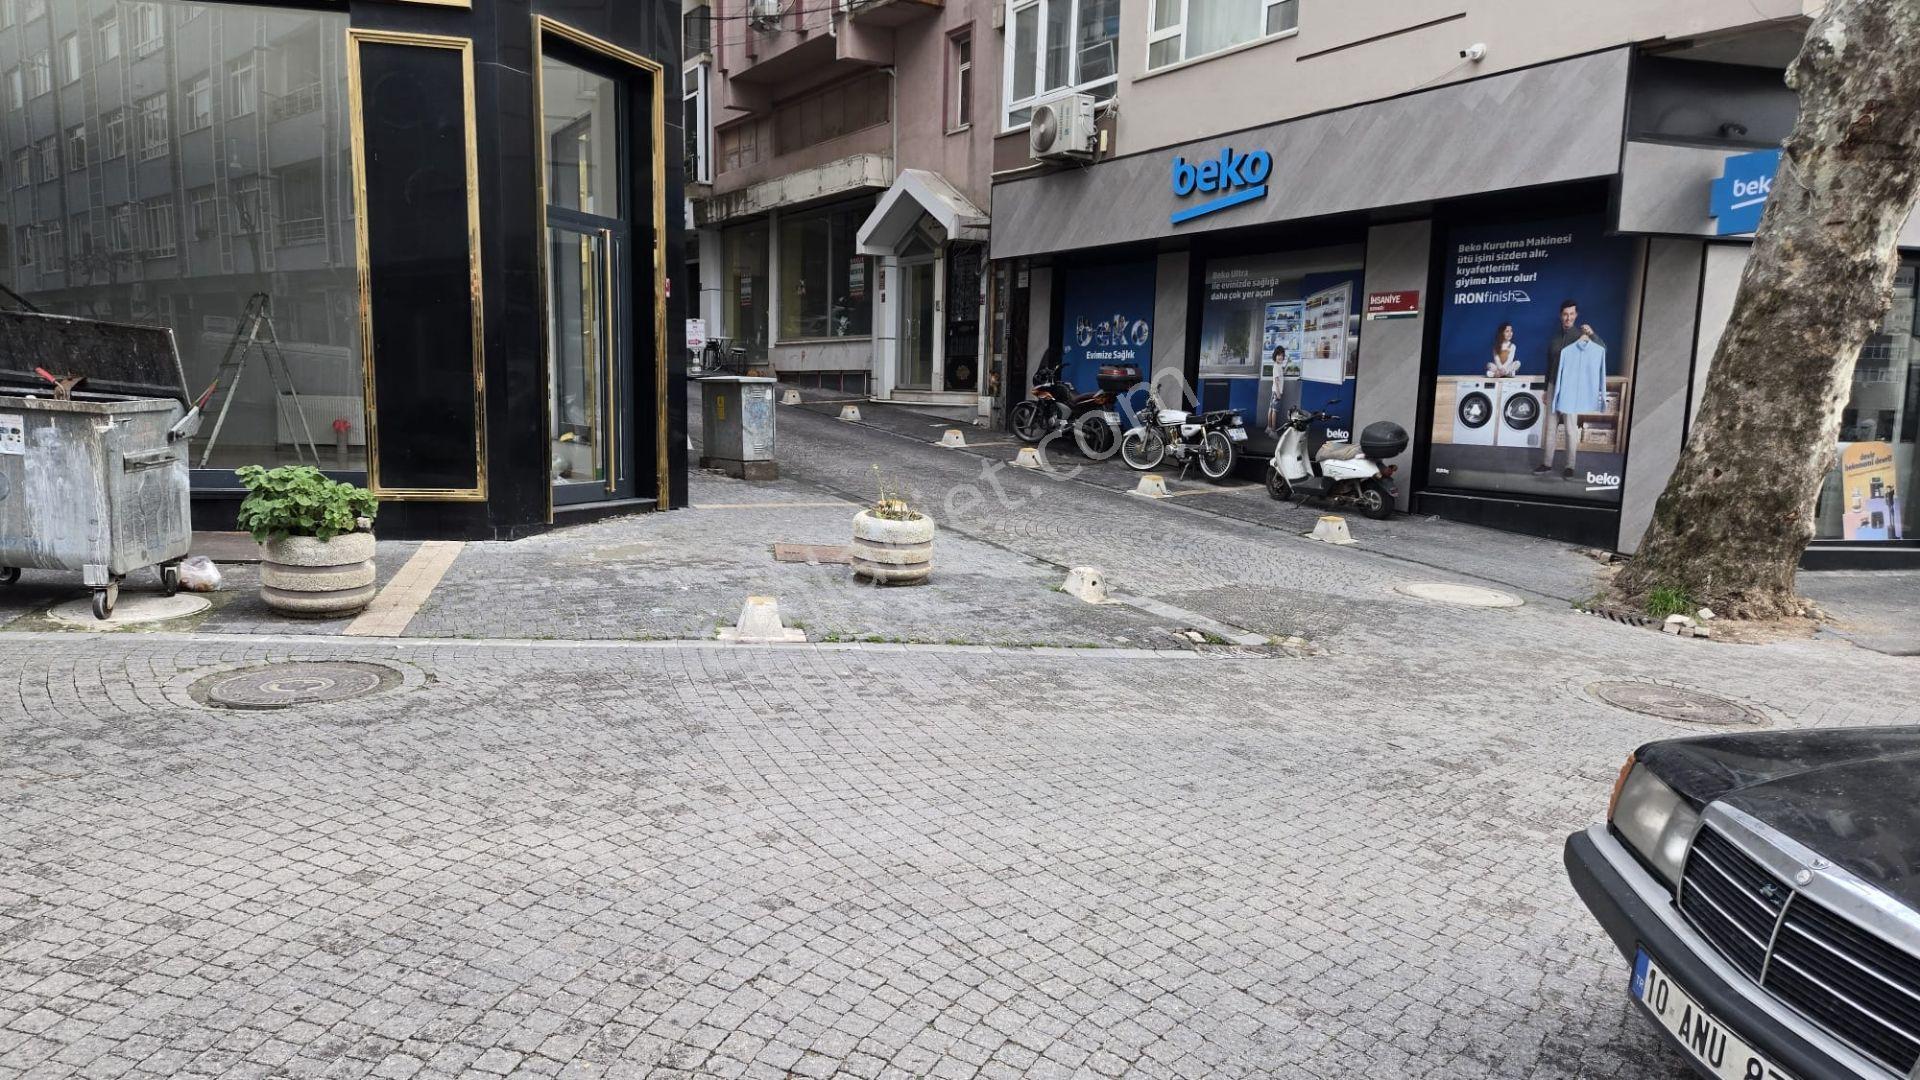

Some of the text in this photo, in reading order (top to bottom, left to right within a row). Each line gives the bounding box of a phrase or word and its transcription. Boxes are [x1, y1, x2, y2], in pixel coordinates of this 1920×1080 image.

[1172, 147, 1272, 196] beko
[1733, 175, 1773, 197] bek
[1458, 234, 1572, 253] Beko Kurutma Makinesi
[1457, 248, 1548, 264] ütü işini sizden alır,
[1456, 262, 1520, 277] kıyafetleriniz
[1455, 272, 1537, 288] giyime hazır olur!
[1454, 290, 1515, 304] IRONfinish
[1076, 314, 1149, 347] beko
[1326, 428, 1349, 439] beko
[1586, 471, 1620, 486] beko
[1647, 969, 1791, 1080] 10 ANU 8
